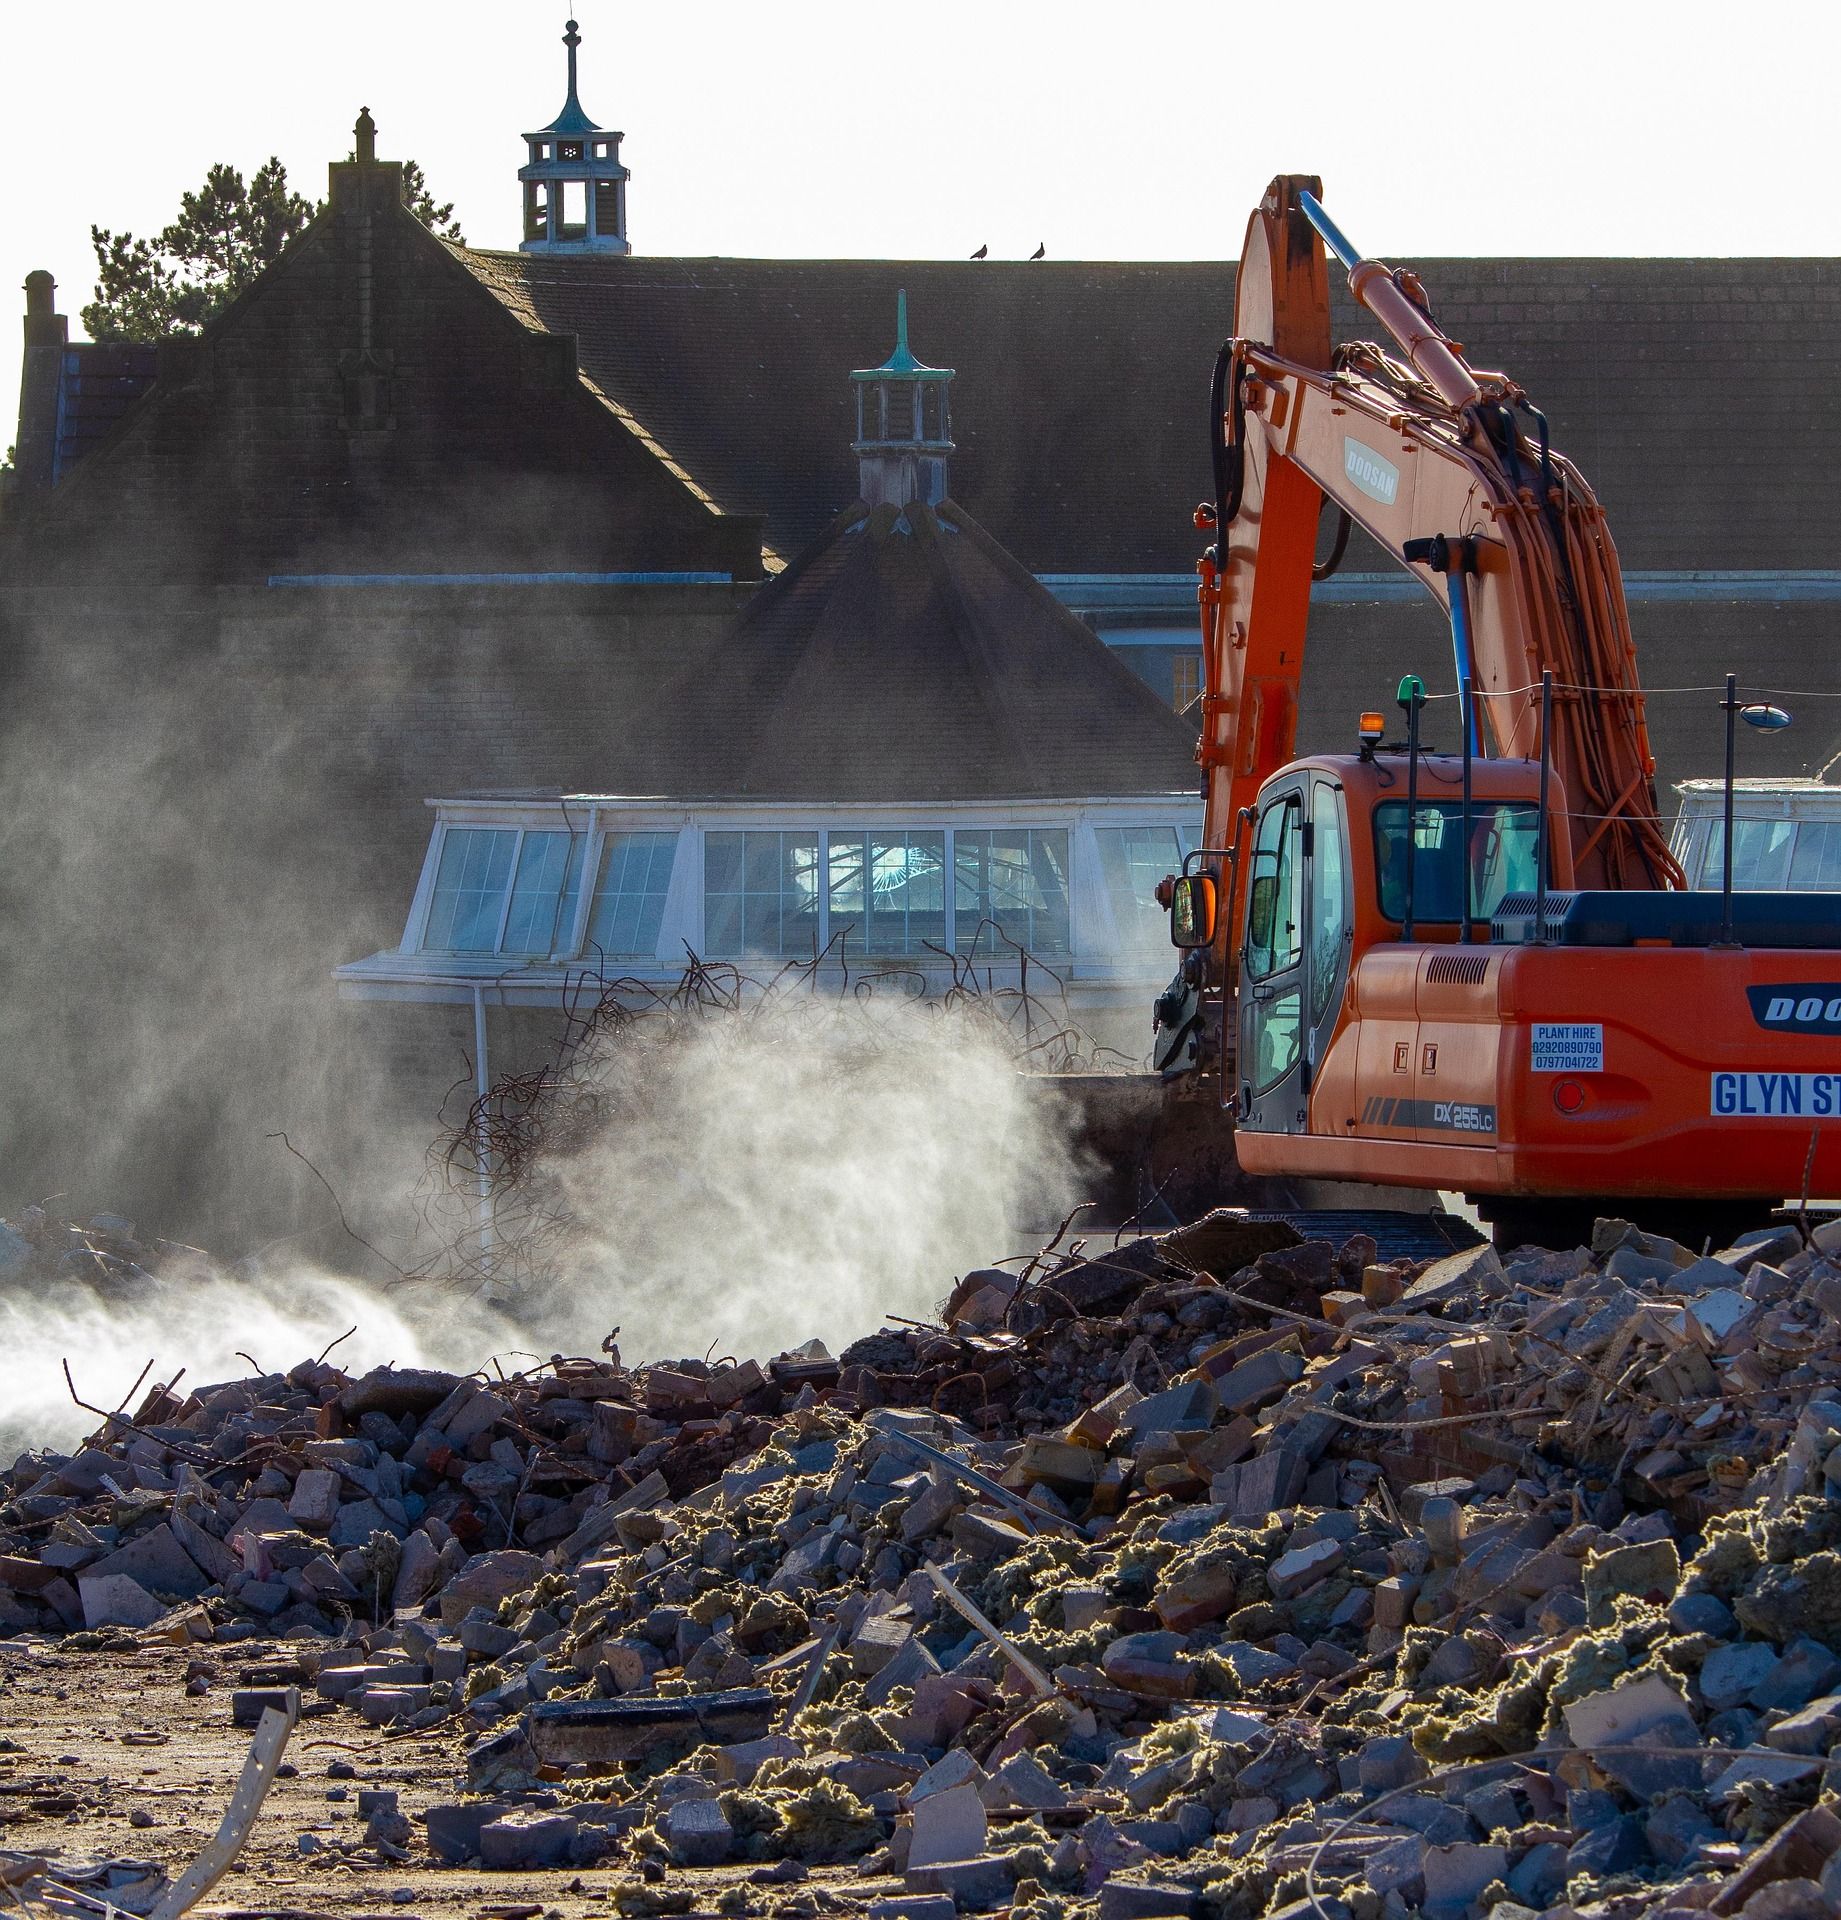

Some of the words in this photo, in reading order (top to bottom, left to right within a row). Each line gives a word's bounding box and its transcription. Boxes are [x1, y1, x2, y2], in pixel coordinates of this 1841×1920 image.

[1347, 450, 1394, 497] DOOSAN
[1539, 1027, 1570, 1039] PLANT
[1572, 1027, 1596, 1039] HIRE
[1533, 1041, 1602, 1054] 02920890790
[1536, 1056, 1598, 1069] 07977041722
[1716, 1073, 1802, 1114] GLYN
